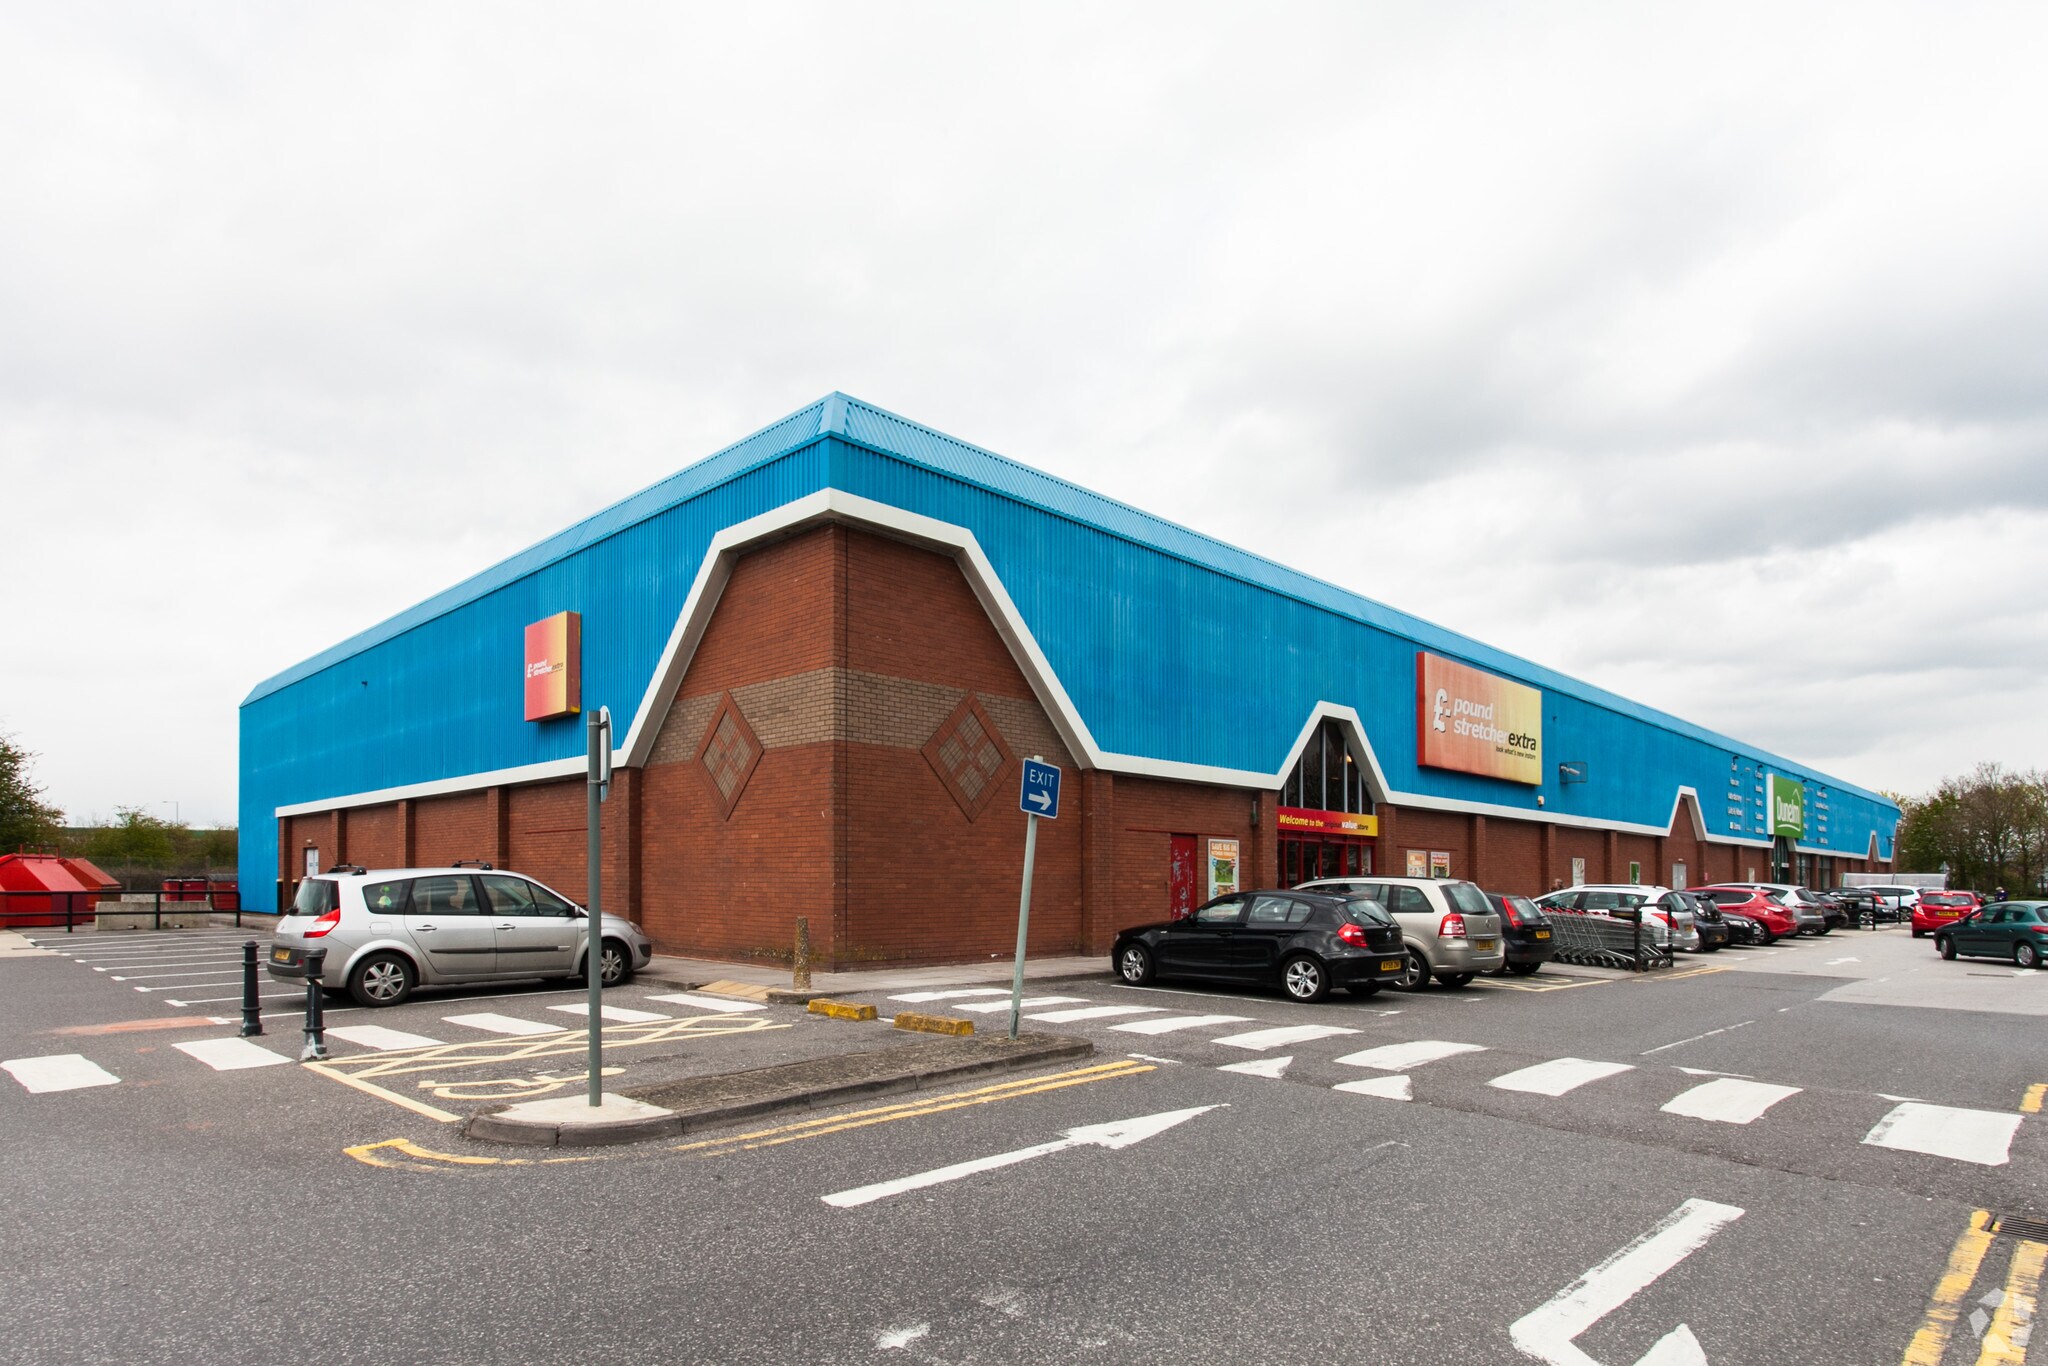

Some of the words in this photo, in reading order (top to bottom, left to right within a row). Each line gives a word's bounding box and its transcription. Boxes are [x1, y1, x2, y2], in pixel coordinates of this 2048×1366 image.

[1453, 698, 1494, 720] pound
[1454, 718, 1509, 745] stretcher
[1508, 732, 1537, 751] extra
[1029, 768, 1055, 787] EXIT
[1777, 795, 1800, 825] Dunelm
[1280, 814, 1309, 826] Welcome
[1309, 819, 1315, 827] to
[1315, 820, 1324, 828] the
[1341, 820, 1358, 830] value
[1357, 823, 1369, 831] store
